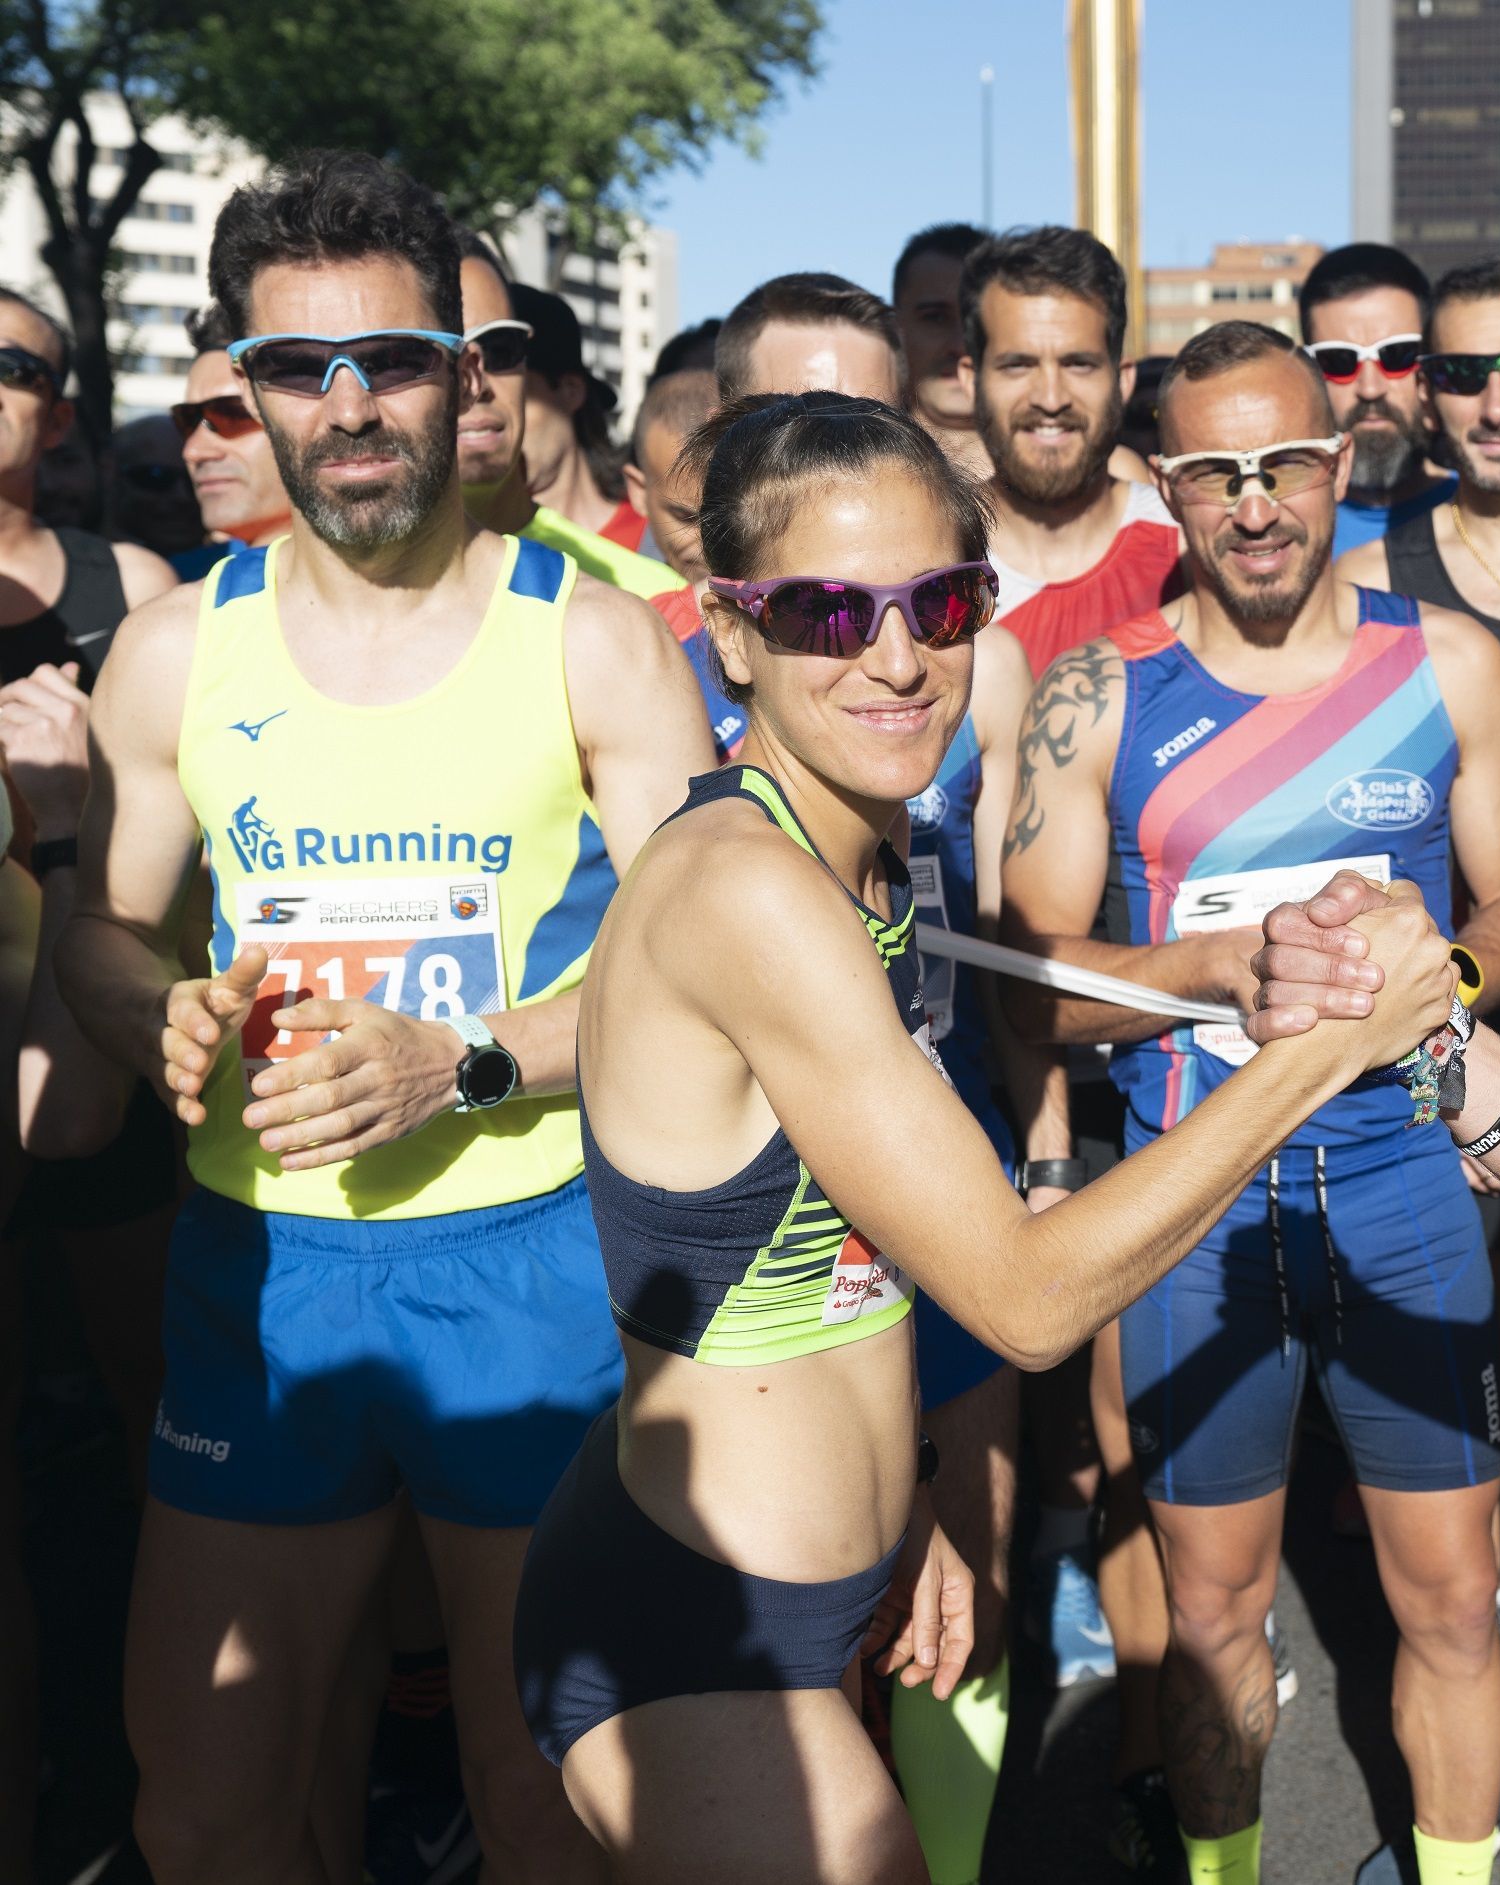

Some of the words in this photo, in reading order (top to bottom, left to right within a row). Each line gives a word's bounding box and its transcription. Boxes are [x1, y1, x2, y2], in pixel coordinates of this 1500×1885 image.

[294, 823, 513, 874] Running
[318, 899, 439, 916] SKECHERS
[319, 913, 439, 925] PERFORMANCE
[265, 952, 467, 1045] 7178
